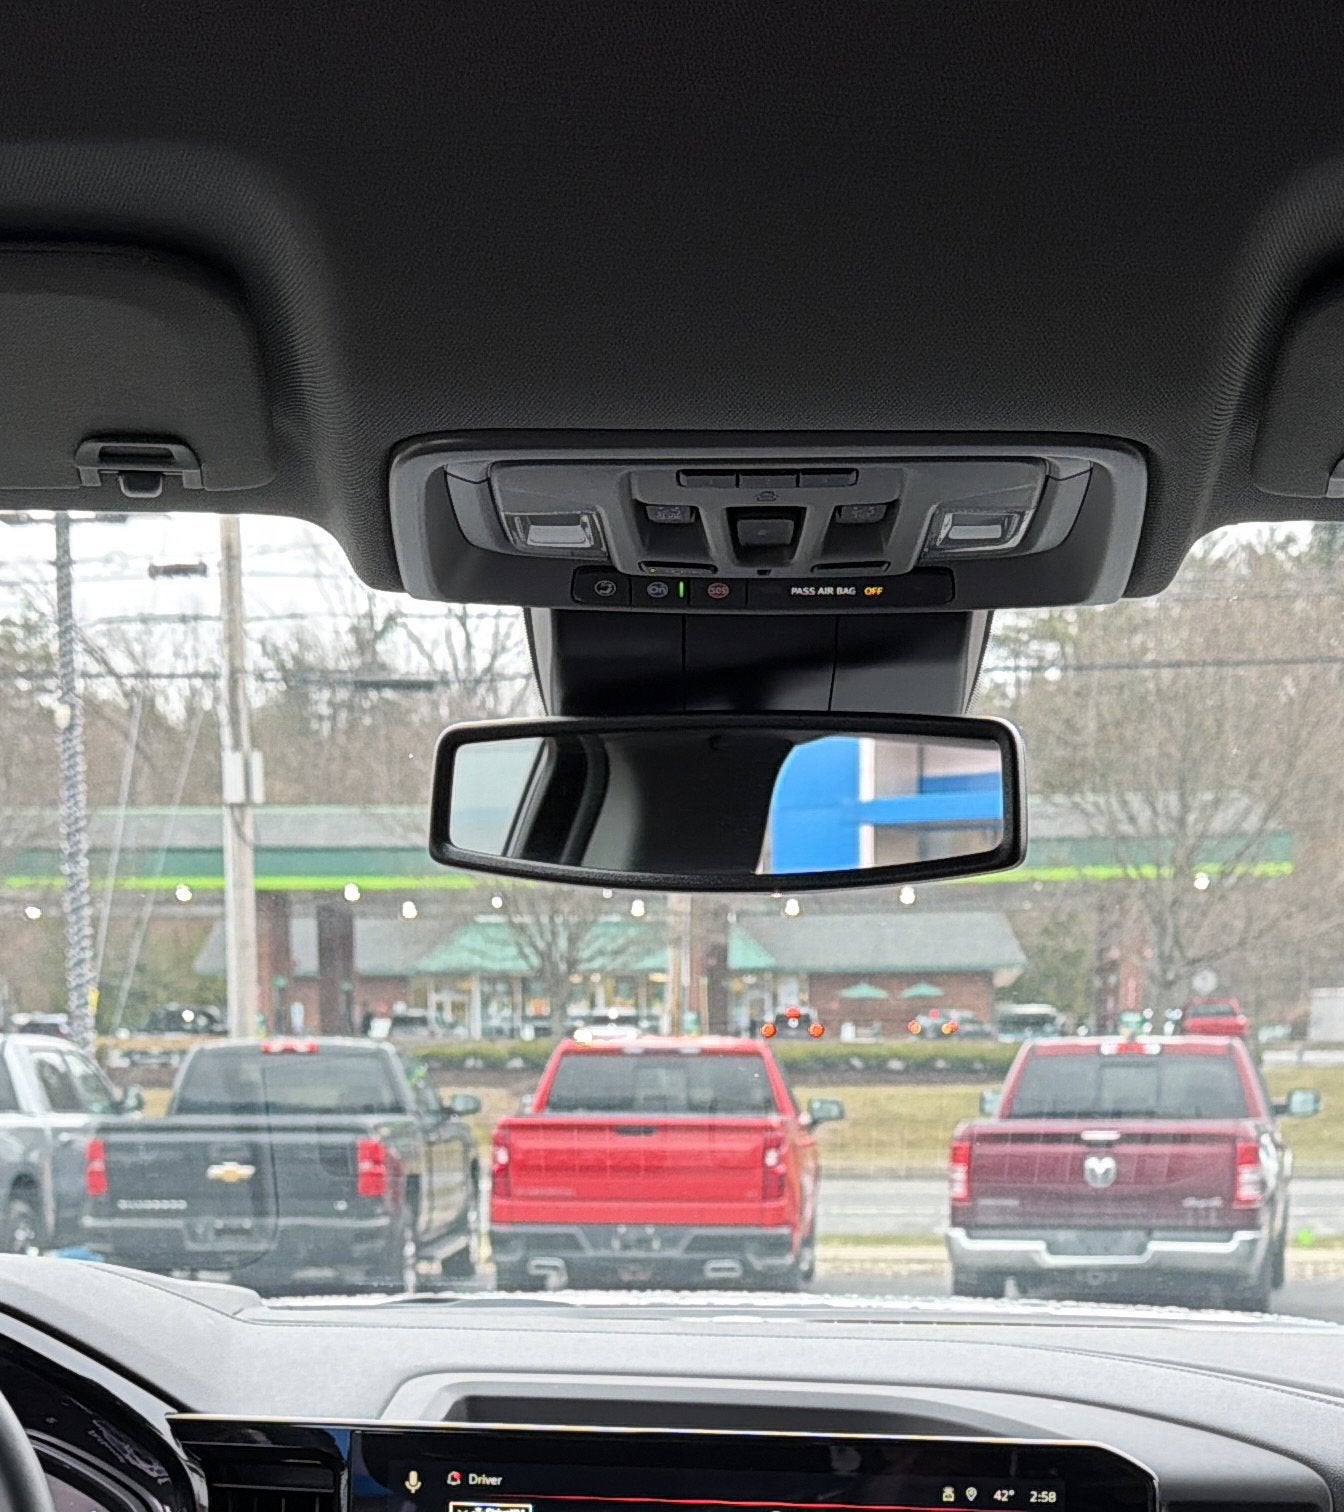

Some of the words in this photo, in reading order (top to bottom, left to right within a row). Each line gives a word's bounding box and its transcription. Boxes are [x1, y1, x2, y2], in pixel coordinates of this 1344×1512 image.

[791, 586, 816, 596] PASS
[817, 586, 834, 596] AIR
[836, 586, 856, 596] BAG
[864, 586, 885, 596] OFF
[468, 1473, 503, 1486] Driver
[993, 1489, 1015, 1501] 42°
[1029, 1491, 1056, 1503] 2:58
